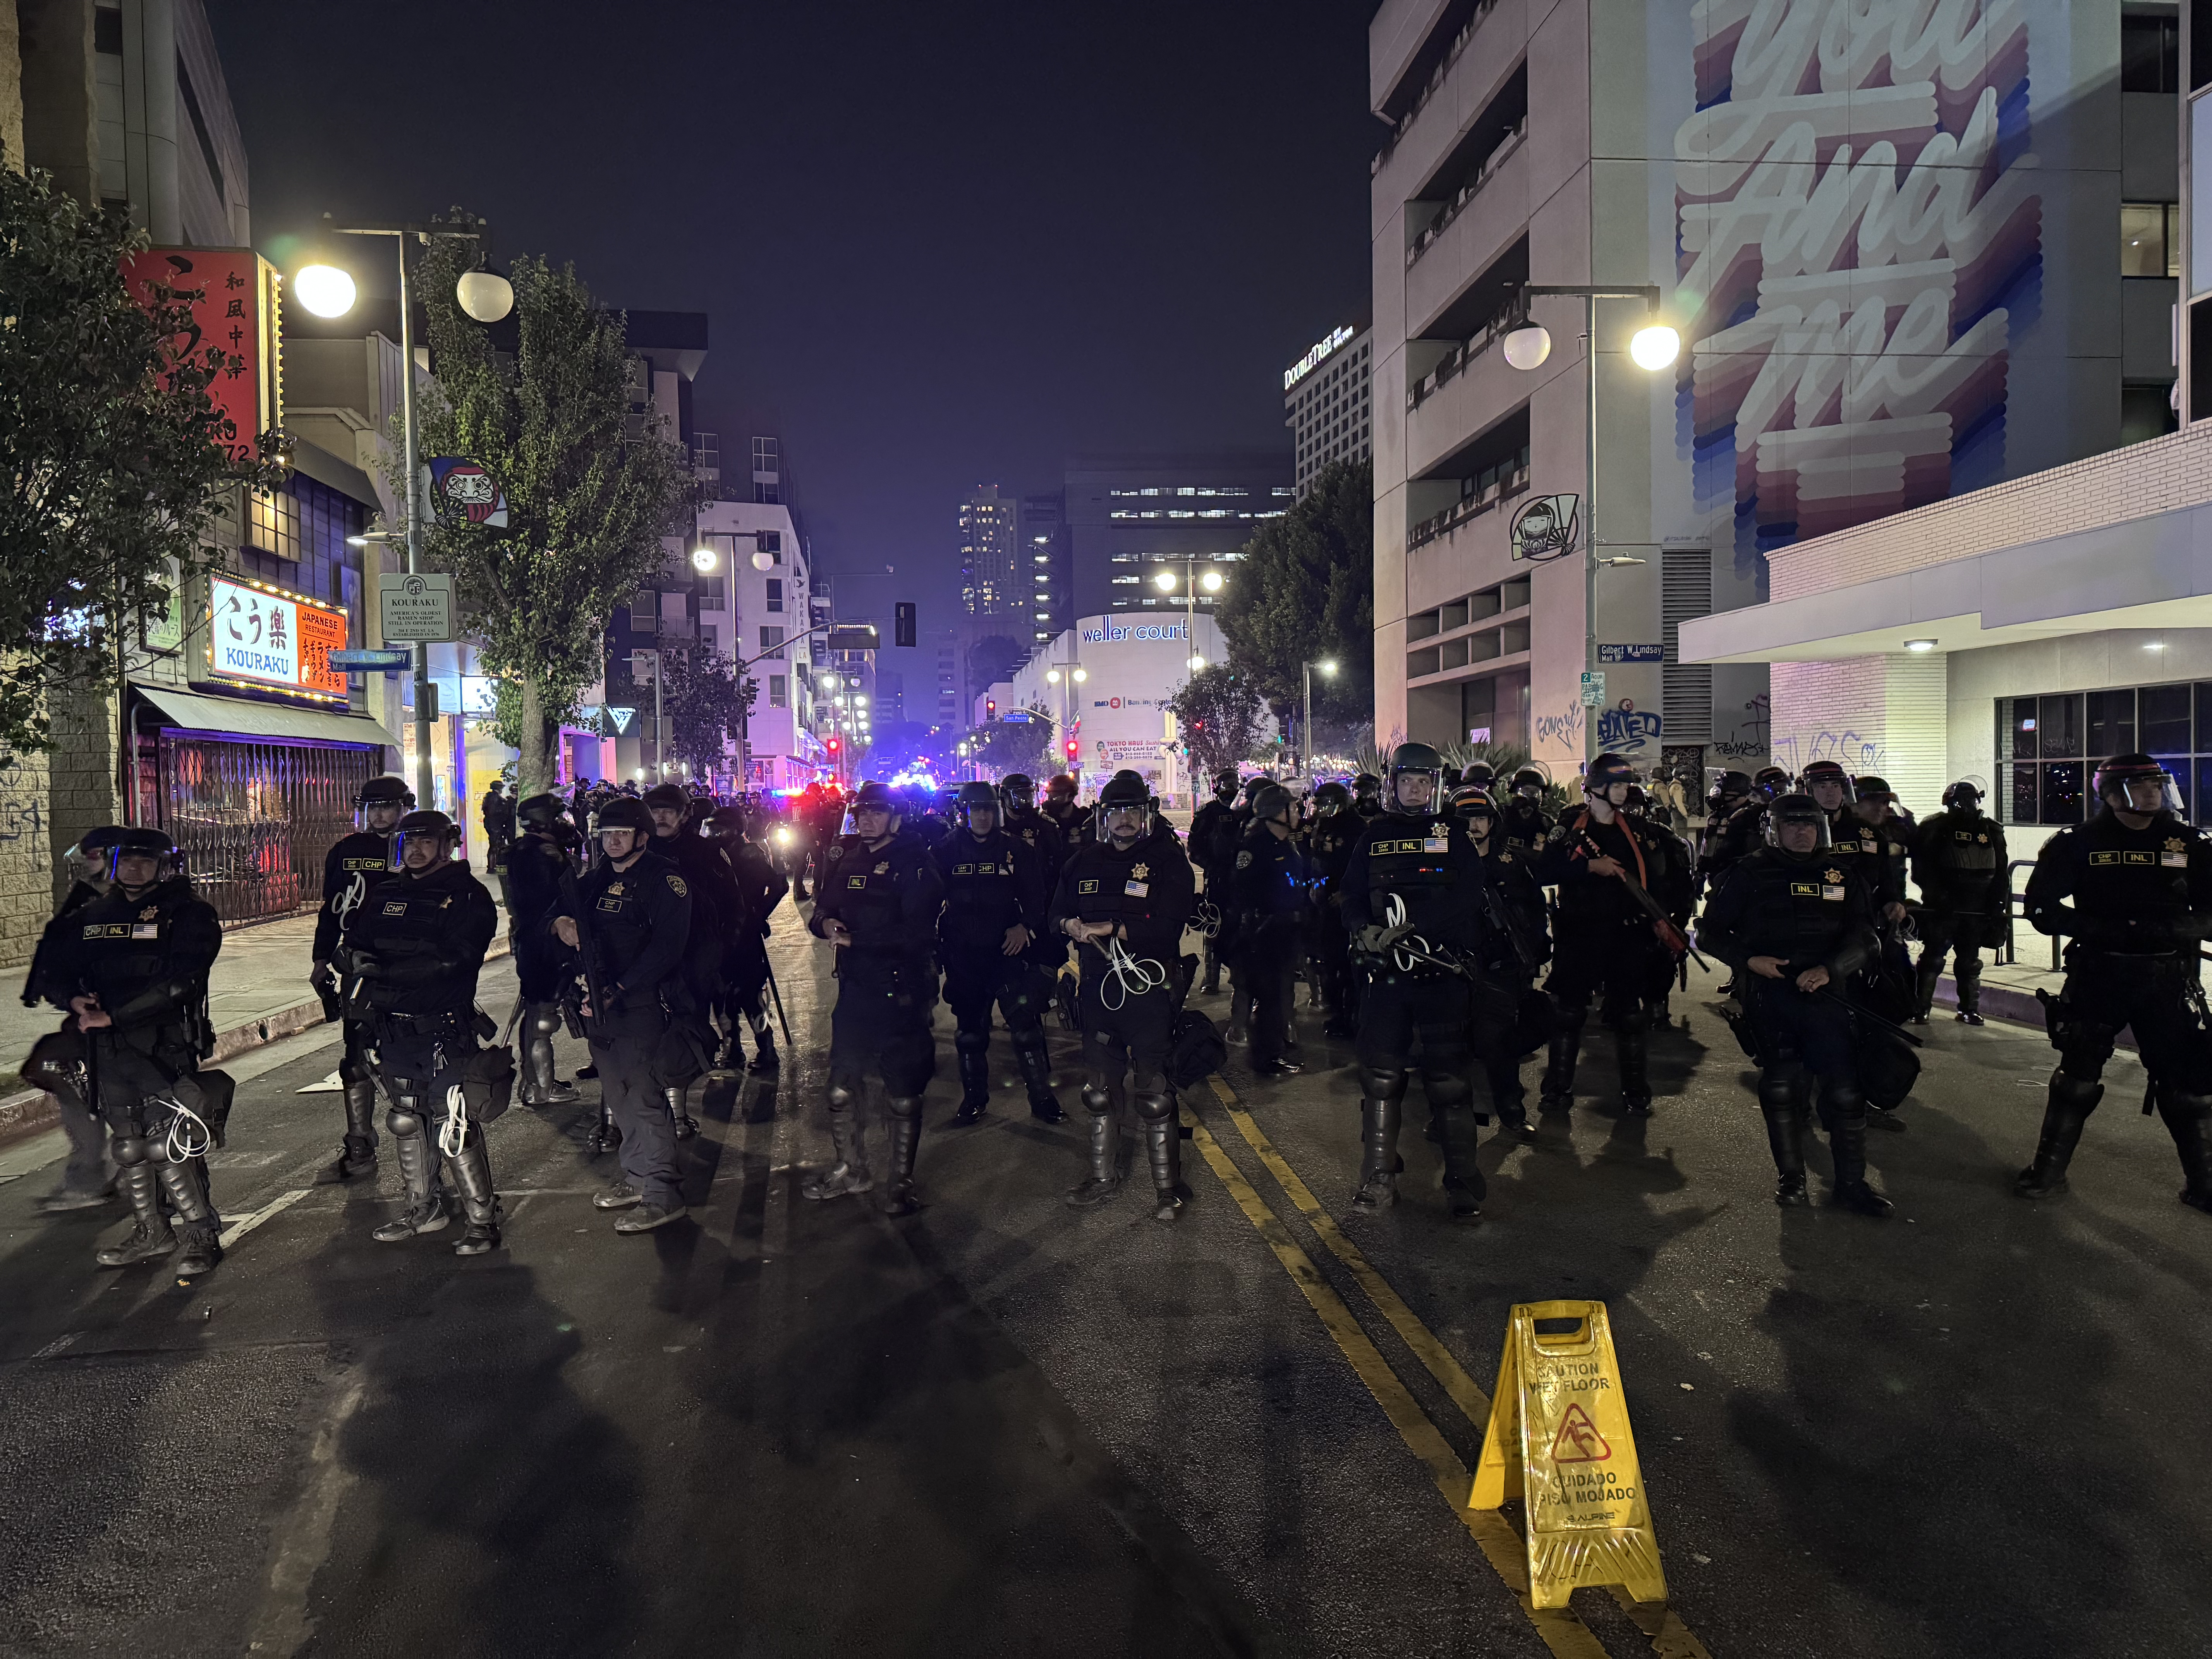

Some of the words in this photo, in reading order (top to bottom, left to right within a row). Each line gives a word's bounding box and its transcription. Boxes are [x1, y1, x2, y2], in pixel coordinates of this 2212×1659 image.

[227, 595, 287, 650] こう楽
[302, 611, 338, 630] JAPANESE
[305, 624, 335, 638] RESTAURANT
[1083, 615, 1132, 644] weller
[1135, 618, 1188, 640] court
[1602, 646, 1624, 654] Gilbert
[1636, 645, 1662, 656] Lindsay
[226, 647, 289, 675] KOURAKU
[1537, 1362, 1599, 1378] CAUTION
[1564, 1377, 1611, 1392] FLOOR
[1552, 1472, 1617, 1489] CUIDADO
[1576, 1487, 1637, 1503] MOJADO
[1577, 1511, 1615, 1522] ALPINE
